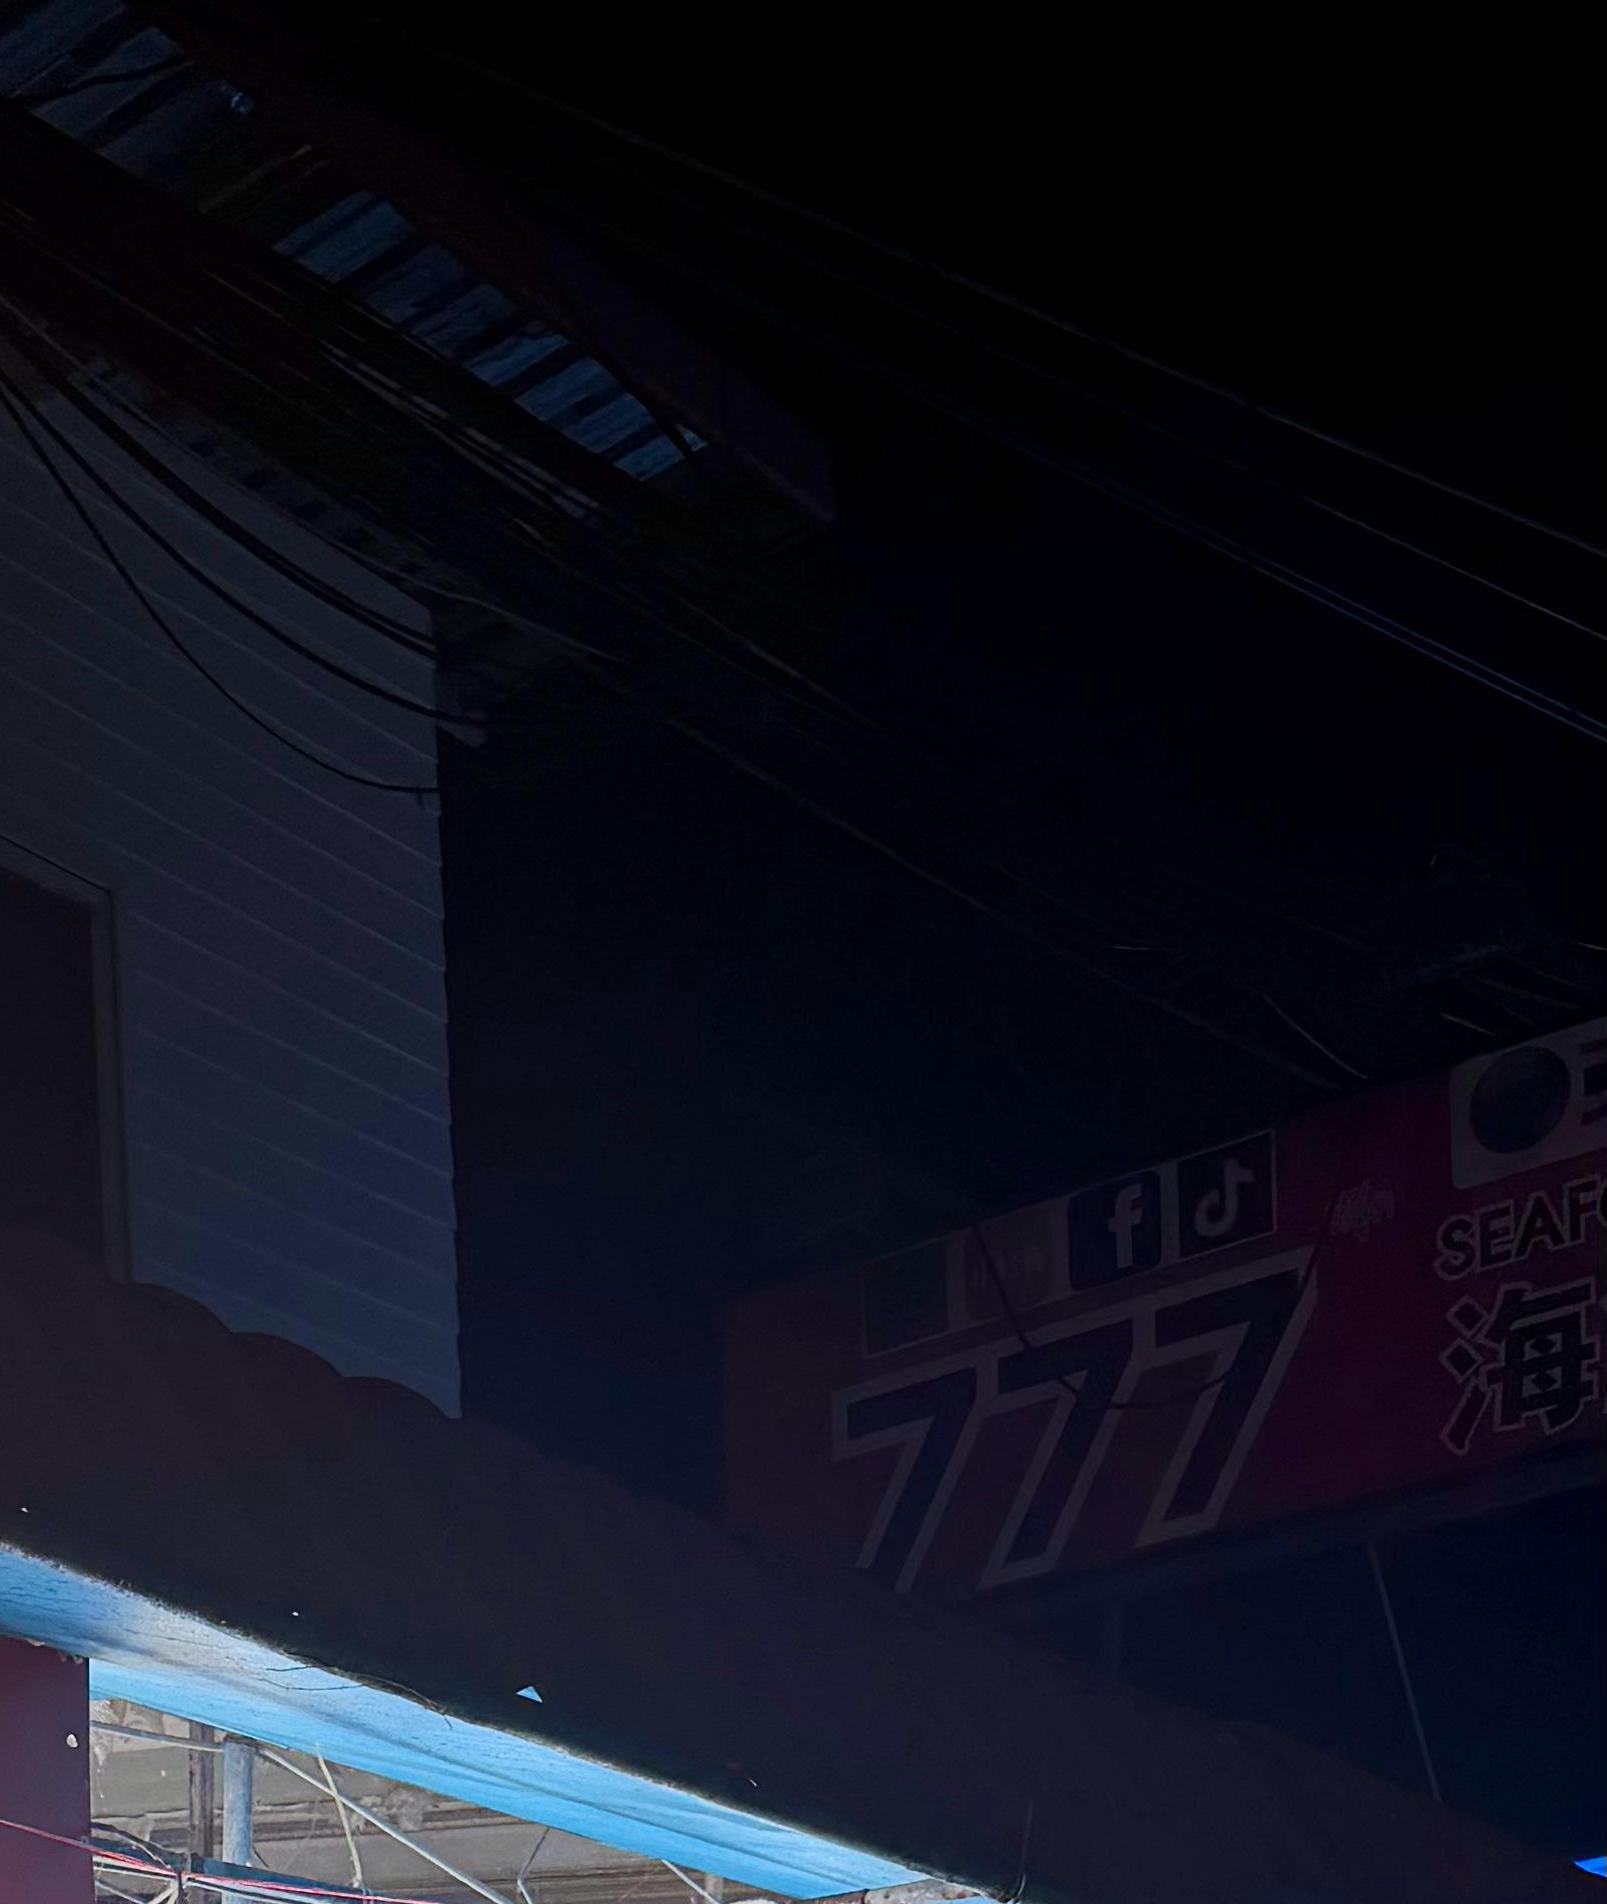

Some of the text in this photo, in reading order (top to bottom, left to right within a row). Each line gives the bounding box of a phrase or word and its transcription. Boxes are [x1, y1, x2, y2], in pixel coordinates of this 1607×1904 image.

[1434, 1171, 1607, 1281] SEAF
[831, 1244, 1318, 1595] 777
[1439, 1279, 1607, 1456] 海
